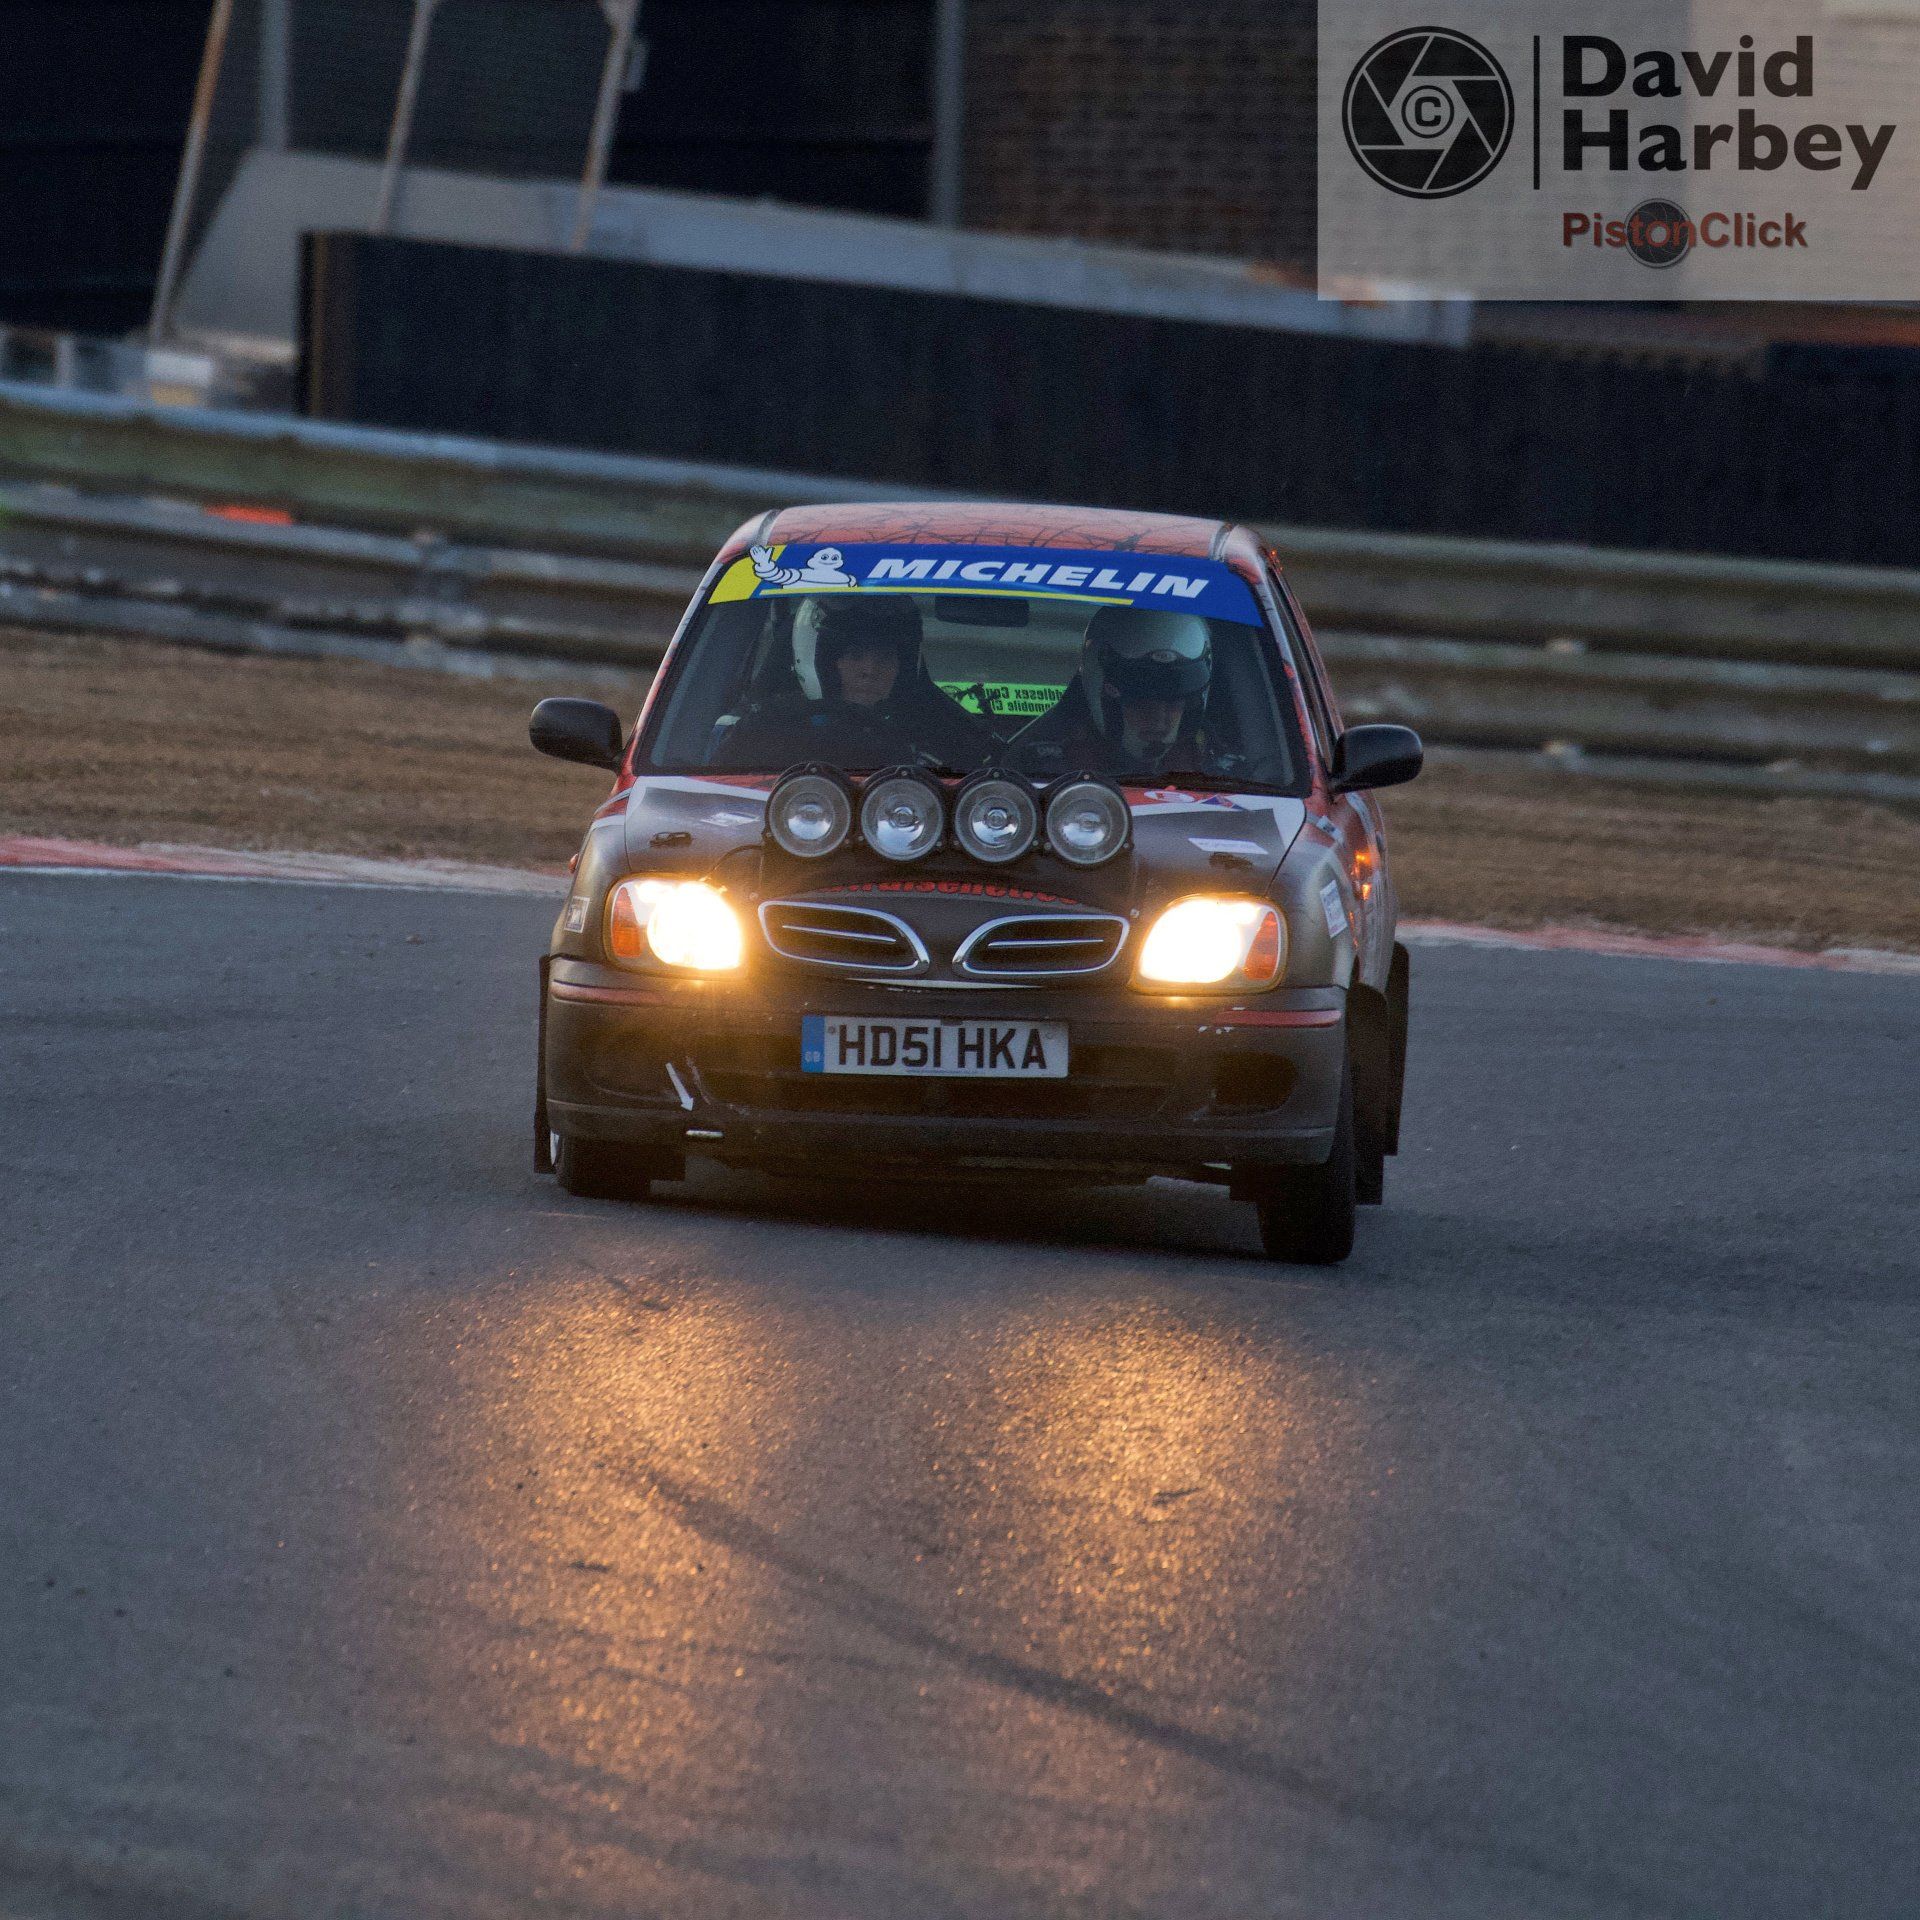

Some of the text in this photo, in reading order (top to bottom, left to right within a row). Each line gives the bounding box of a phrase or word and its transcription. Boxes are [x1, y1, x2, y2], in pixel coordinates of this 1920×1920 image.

[866, 558, 1209, 598] MICHELIN
[838, 1025, 1048, 1070] HD51 HKA
